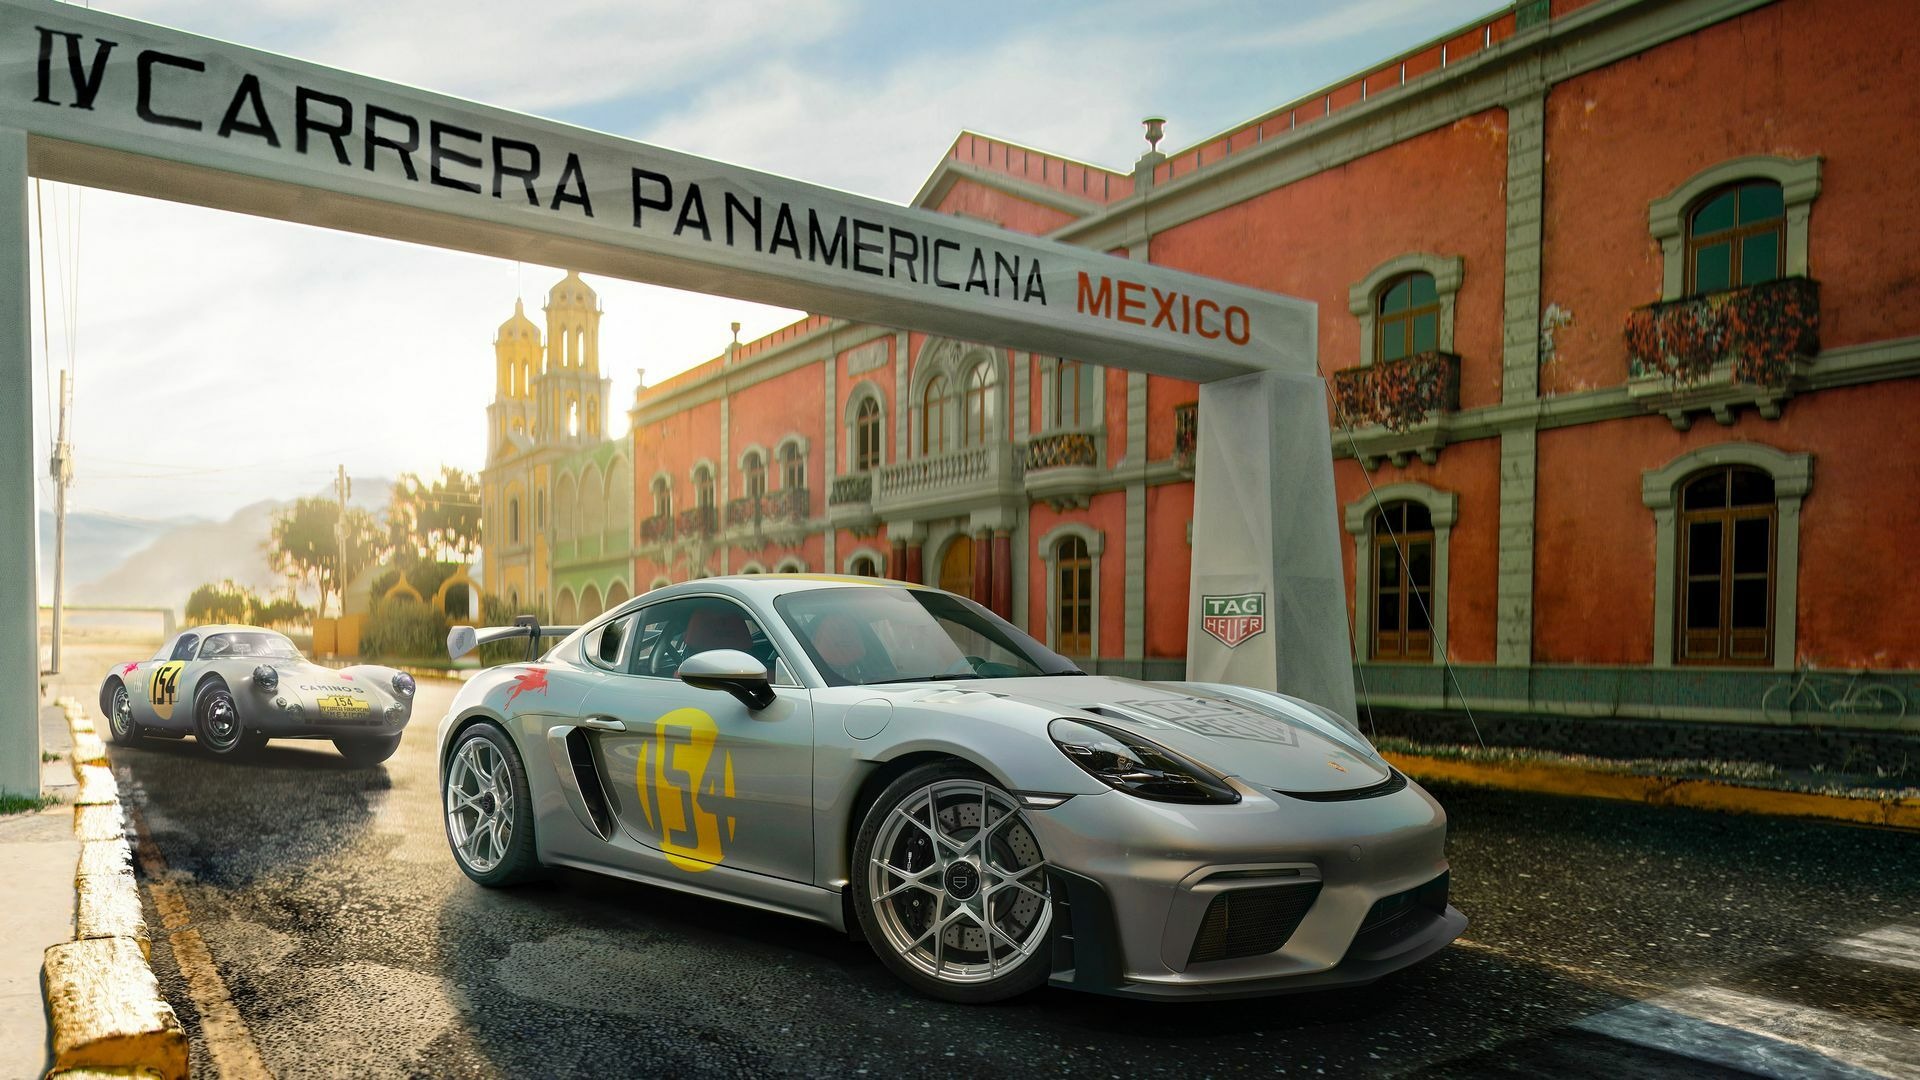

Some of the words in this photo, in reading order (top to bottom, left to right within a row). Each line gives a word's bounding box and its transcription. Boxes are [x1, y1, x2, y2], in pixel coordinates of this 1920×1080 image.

[33, 25, 119, 111] IV
[136, 49, 594, 219] CARRERA
[631, 167, 1047, 306] PANAMERICANA
[1076, 270, 1251, 347] MEXICO
[1208, 597, 1258, 615] TAG
[1207, 618, 1260, 643] HEUER
[152, 666, 182, 705] 154
[334, 697, 354, 707] 154
[645, 723, 737, 857] 154
